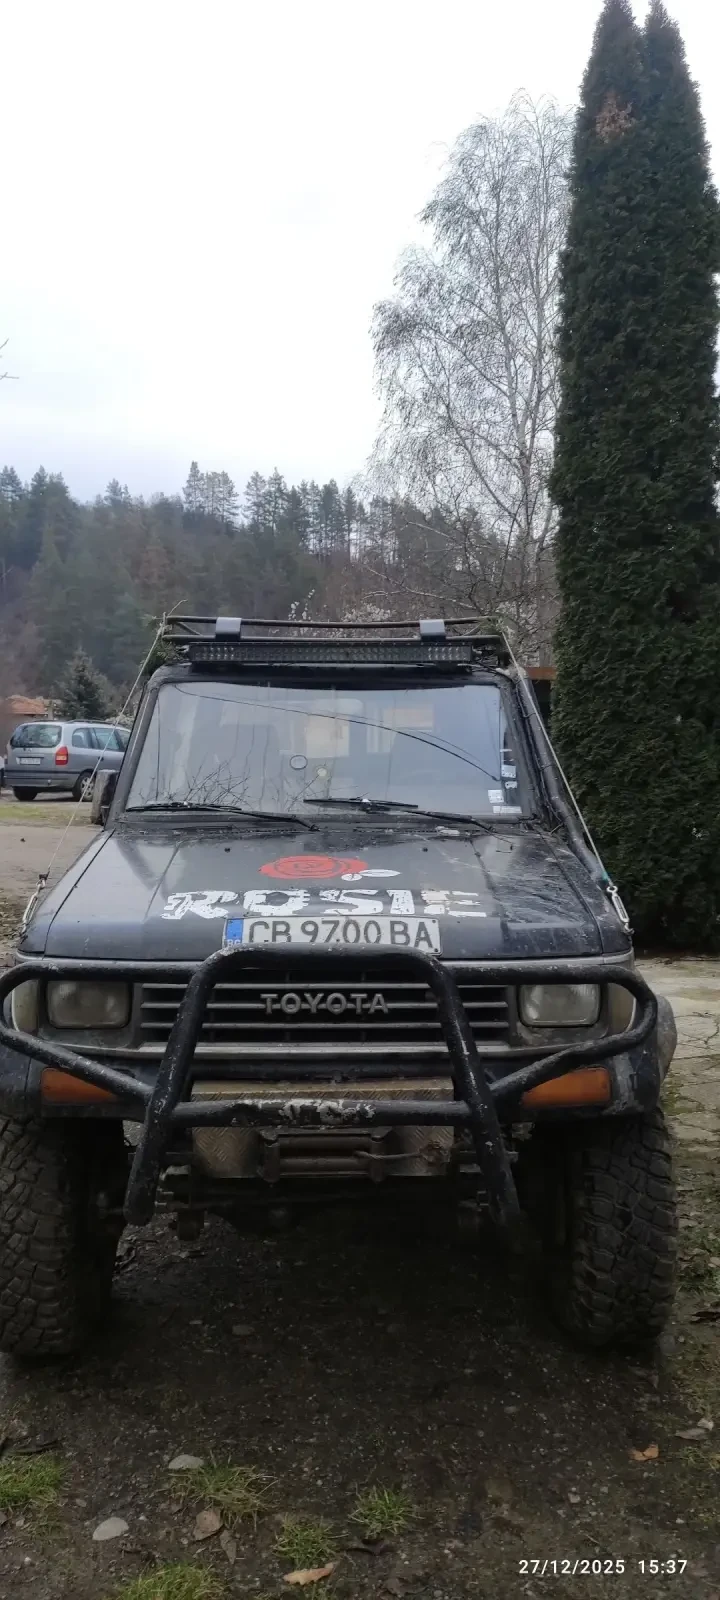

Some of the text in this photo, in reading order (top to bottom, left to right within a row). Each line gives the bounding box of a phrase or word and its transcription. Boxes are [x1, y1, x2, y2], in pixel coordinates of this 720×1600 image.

[161, 889, 487, 920] ROSIE
[249, 920, 434, 948] CB 9700 BA
[260, 992, 389, 1015] TOYOTA
